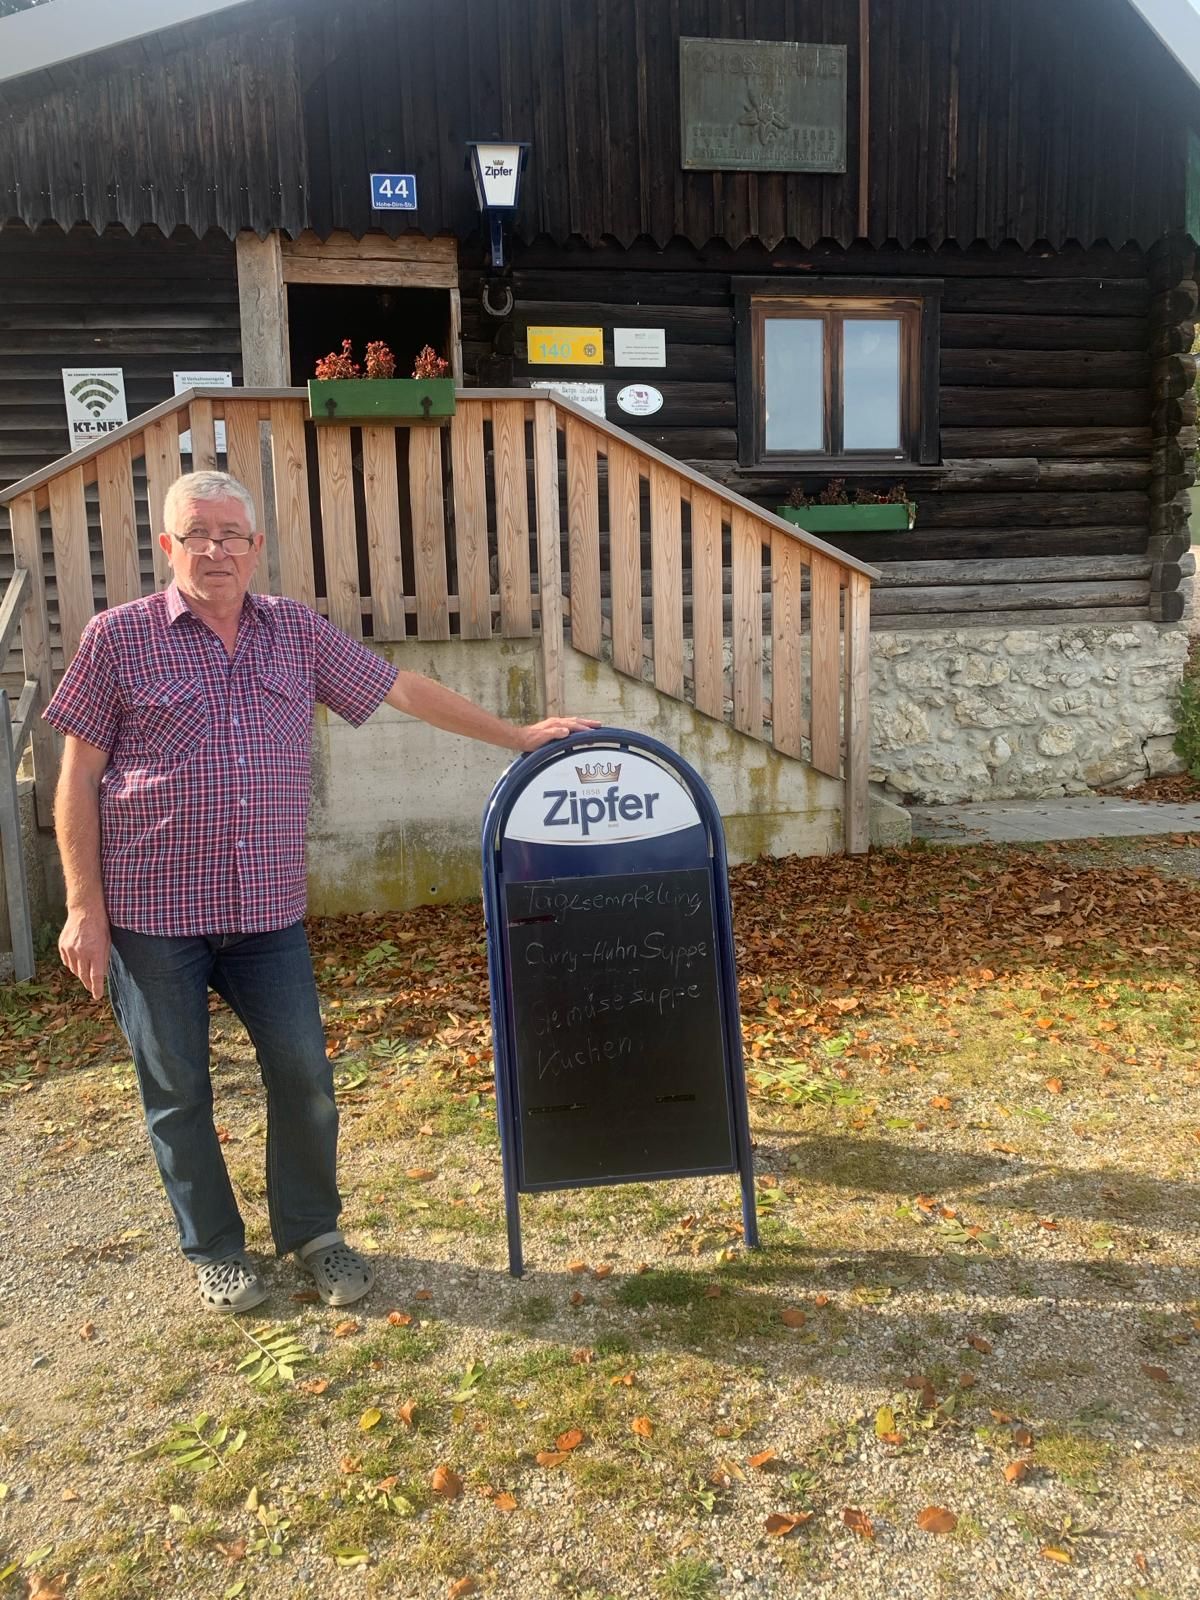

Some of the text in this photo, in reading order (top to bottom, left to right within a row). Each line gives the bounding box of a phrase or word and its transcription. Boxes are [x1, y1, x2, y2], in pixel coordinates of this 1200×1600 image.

[485, 166, 513, 179] Zipfer
[379, 179, 409, 198] 44
[539, 342, 572, 358] 140
[543, 786, 660, 836] Zipfer
[639, 931, 707, 979] Suppe
[537, 1036, 632, 1080] Kuchen
